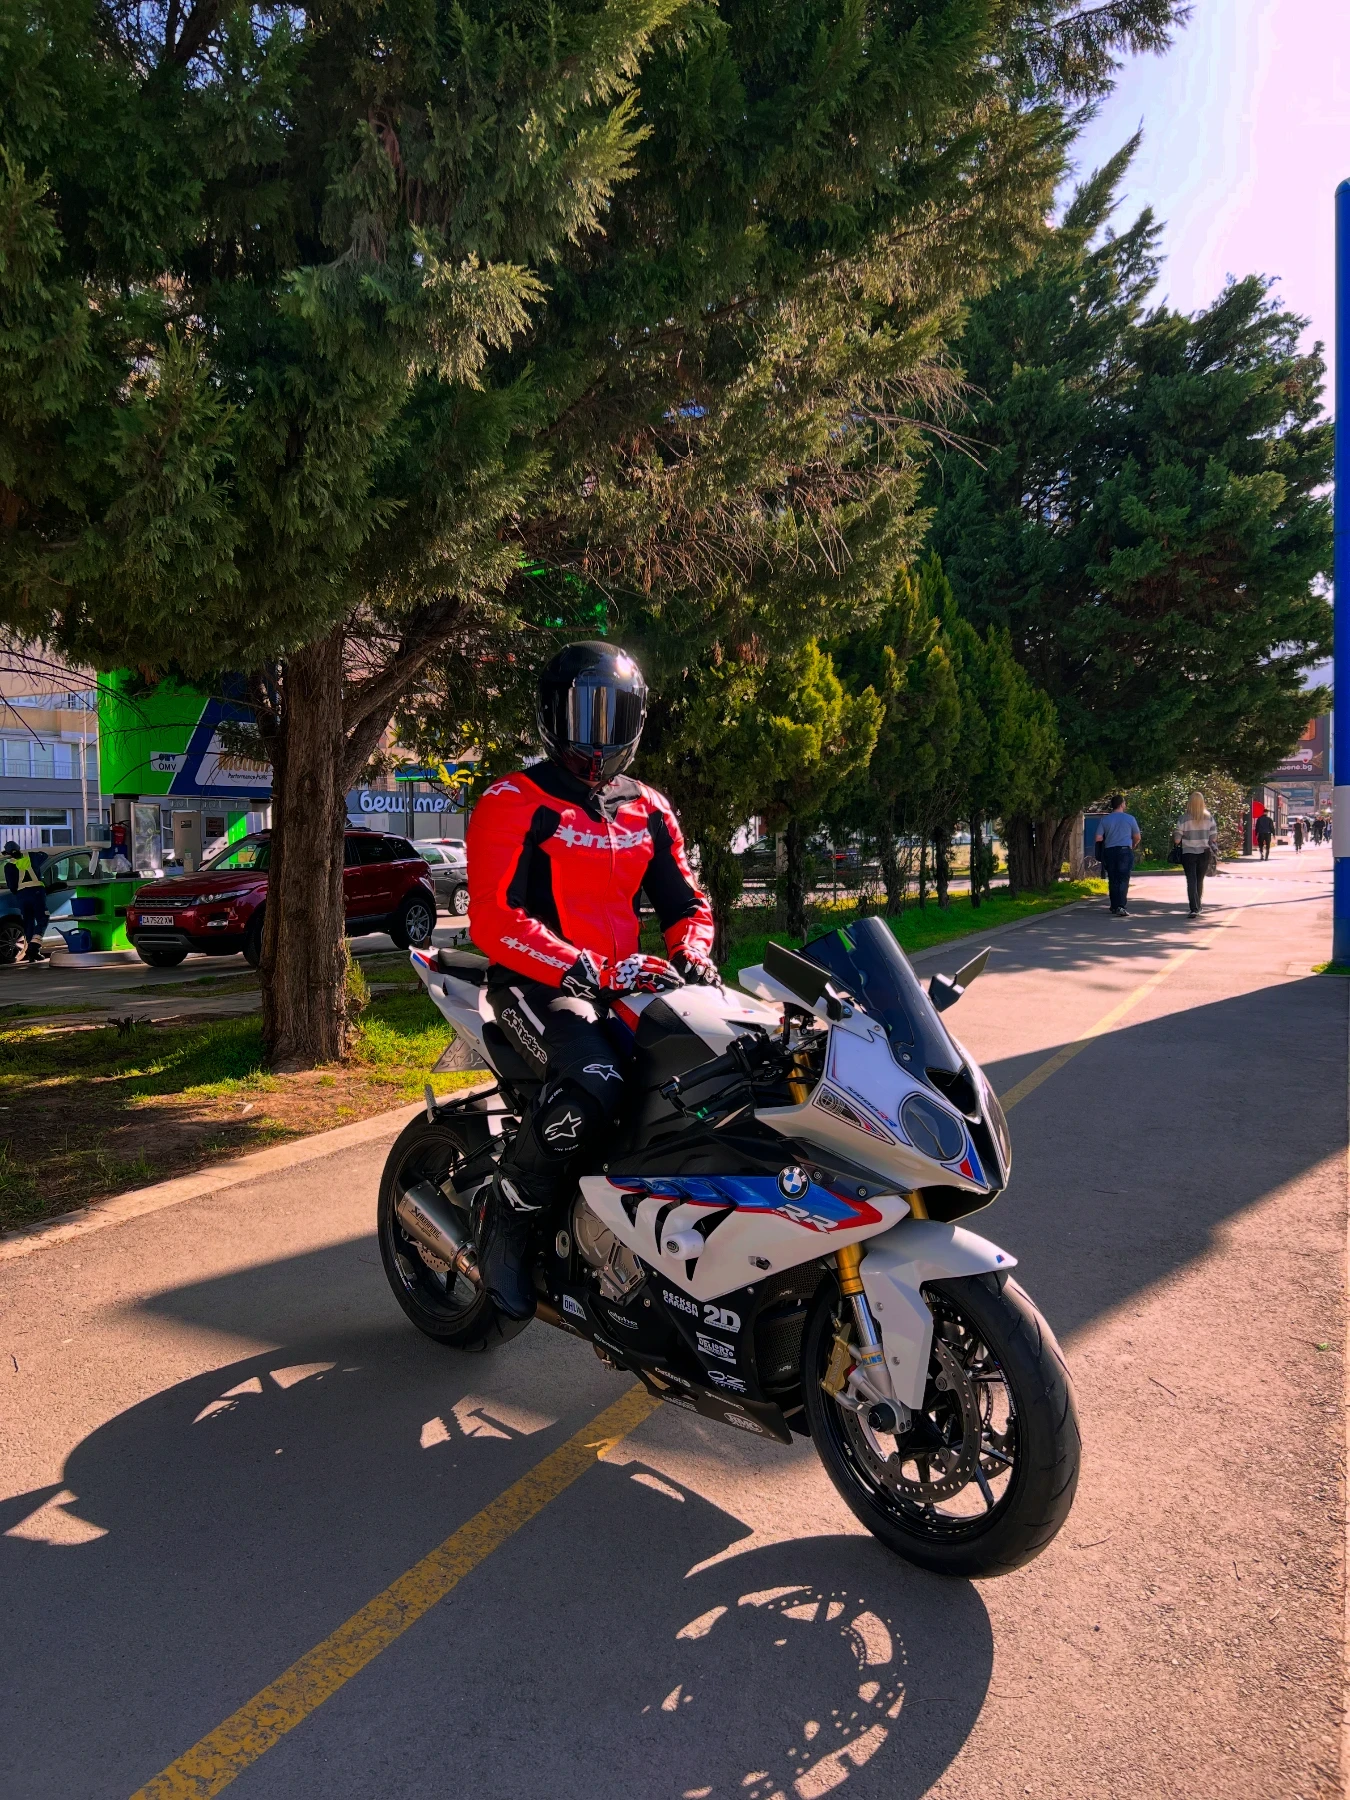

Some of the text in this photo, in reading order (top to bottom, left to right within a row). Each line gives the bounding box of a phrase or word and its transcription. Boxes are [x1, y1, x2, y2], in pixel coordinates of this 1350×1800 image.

[158, 762, 177, 771] OMV
[500, 936, 574, 971] alpinestars
[776, 1203, 839, 1234] RR
[703, 1304, 741, 1329] 2D
